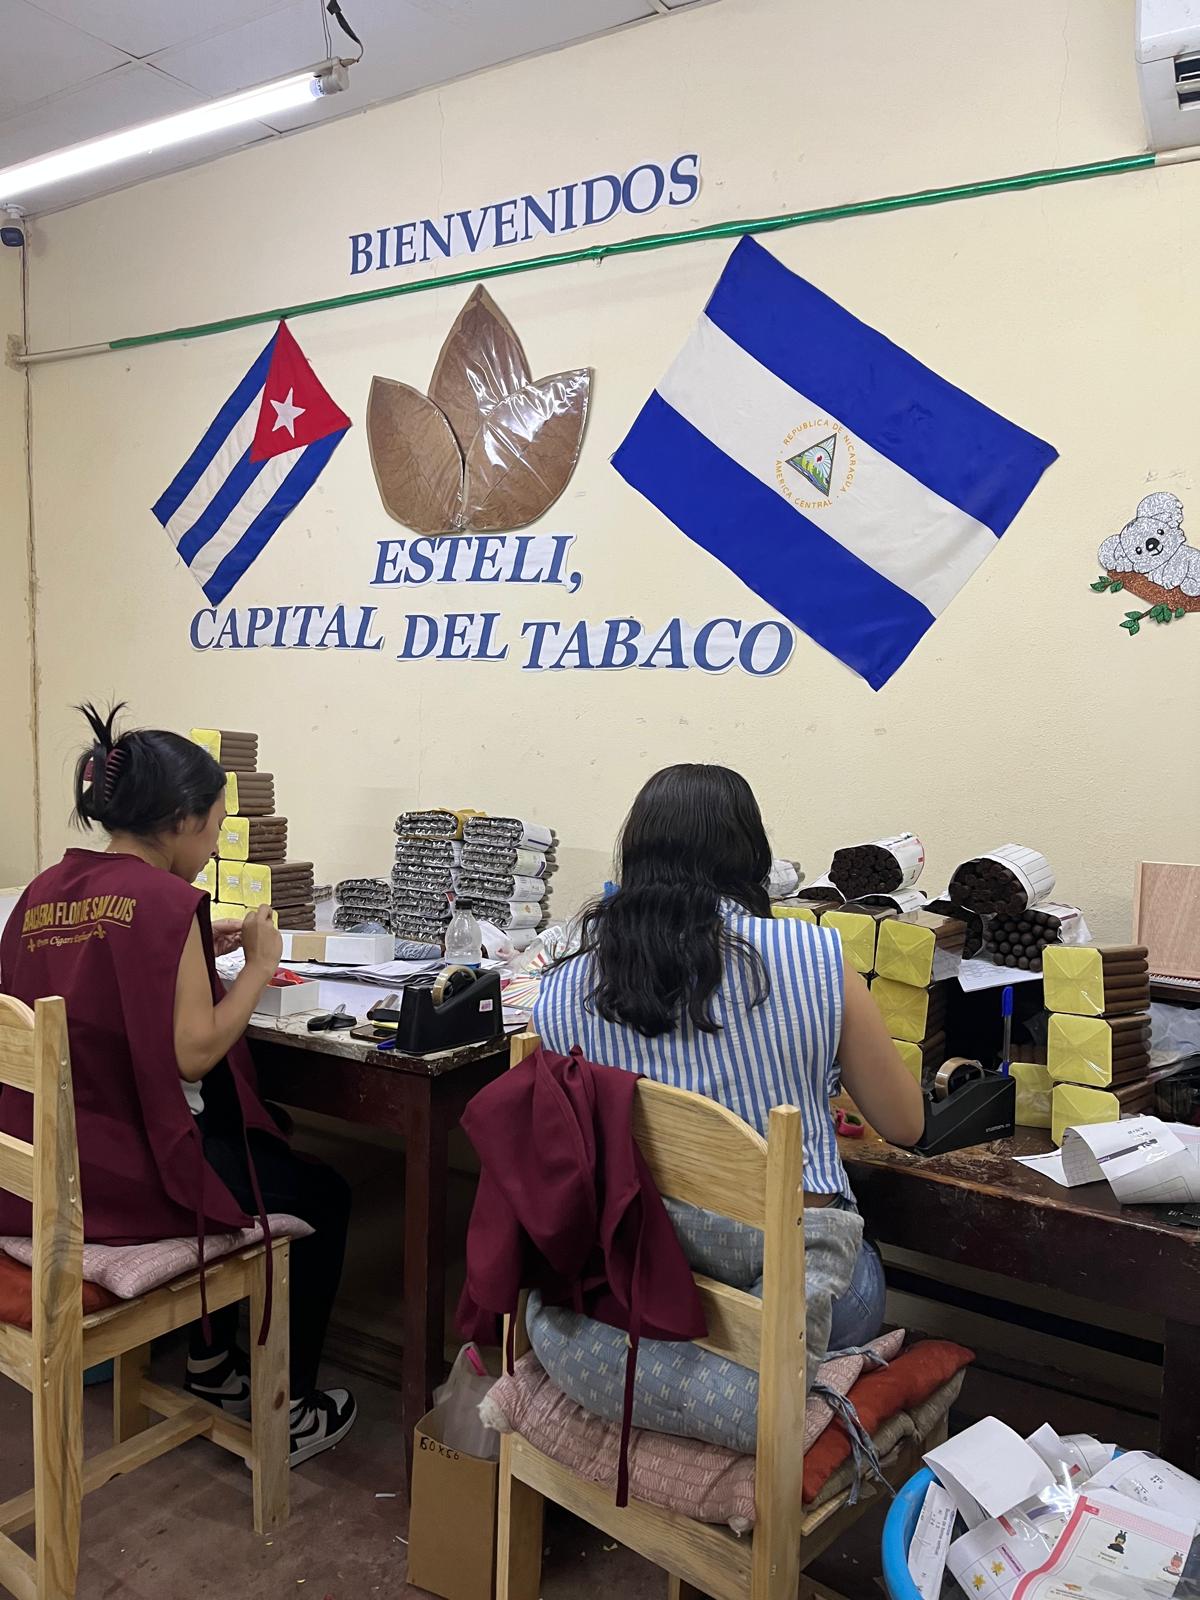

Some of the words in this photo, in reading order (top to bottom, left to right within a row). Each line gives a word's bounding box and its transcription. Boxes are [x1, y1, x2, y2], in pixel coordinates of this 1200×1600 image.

[350, 154, 698, 275] BIENVENIDOS
[775, 459, 793, 498] AMERICA
[794, 497, 833, 509] CENTRAL
[783, 419, 830, 447] REPUBLICA
[832, 423, 844, 434] DE
[840, 434, 857, 493] NICARAGUA
[371, 535, 582, 593] ESTELI,
[190, 605, 380, 649] CAPITAL
[398, 613, 507, 660] DEL
[520, 618, 793, 676] TABACO
[105, 895, 137, 923] LUIS
